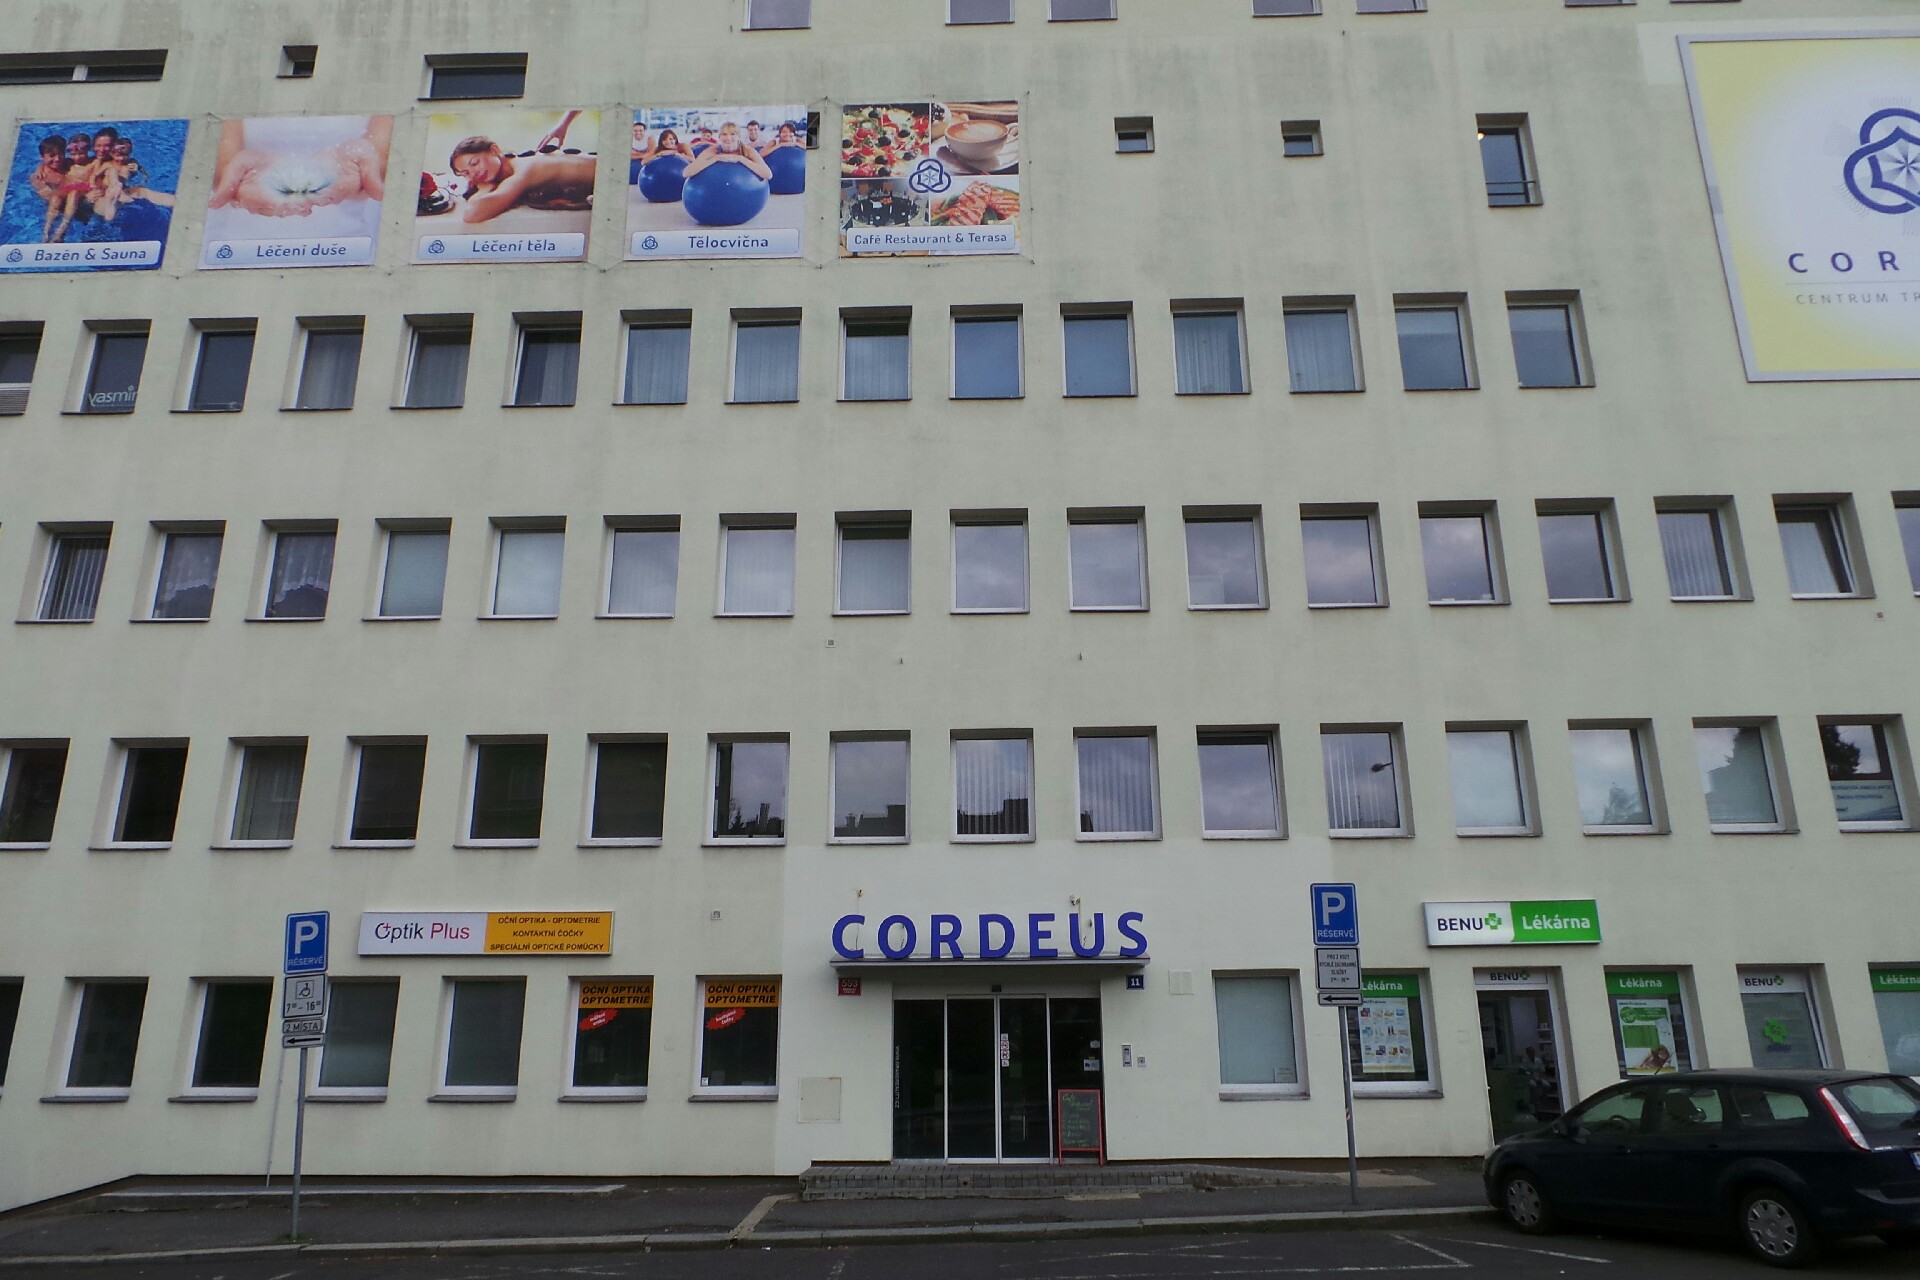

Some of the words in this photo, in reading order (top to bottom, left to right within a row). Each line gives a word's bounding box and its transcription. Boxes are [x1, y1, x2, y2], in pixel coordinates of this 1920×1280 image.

[688, 235, 769, 249] Tělocvična
[854, 234, 881, 245] Café
[885, 234, 951, 245] Restaurant
[955, 233, 964, 243] &
[968, 232, 1007, 243] Terasa
[256, 245, 306, 257] Léčení
[311, 243, 347, 256] duše
[472, 240, 522, 253] Léčení
[527, 239, 556, 252] těla
[34, 248, 79, 261] Bazén
[85, 248, 96, 260] &
[101, 248, 146, 260] Sauna
[1788, 251, 1900, 273] COR
[1796, 293, 1889, 304] CENTRUM
[1321, 892, 1346, 925] P
[498, 916, 517, 924] OČNÍ
[519, 916, 546, 924] OPTIKA
[552, 916, 601, 924] OPTOMETRIE
[1437, 917, 1484, 931] BENU
[1522, 914, 1591, 930] Lékárna
[294, 920, 319, 955] P
[374, 922, 423, 943] Optik
[430, 922, 470, 940] Plus
[513, 929, 556, 937] KONTAKTNÍ
[832, 911, 1149, 960] CORDEUS
[1317, 928, 1354, 938] RÉSERVÉ
[490, 942, 531, 951] SPECIÁLNÍ
[532, 942, 564, 951] OPTICKÉ
[288, 955, 324, 967] RÉSERVÉ
[1130, 977, 1140, 986] 11
[1490, 972, 1519, 981] BENU
[1744, 977, 1773, 987] BENU
[707, 984, 735, 993] OČNÍ
[737, 985, 776, 993] OPTIKA
[1361, 980, 1403, 991] Lékárna
[1619, 978, 1663, 988] Lékárna
[582, 984, 609, 994] OČNÍ
[611, 985, 651, 994] OPTIKA
[582, 996, 651, 1004] OPTOMETRIE
[707, 995, 776, 1004] OPTOMETRIE
[286, 1023, 291, 1032] 2
[293, 1021, 319, 1031] MÍSTA
